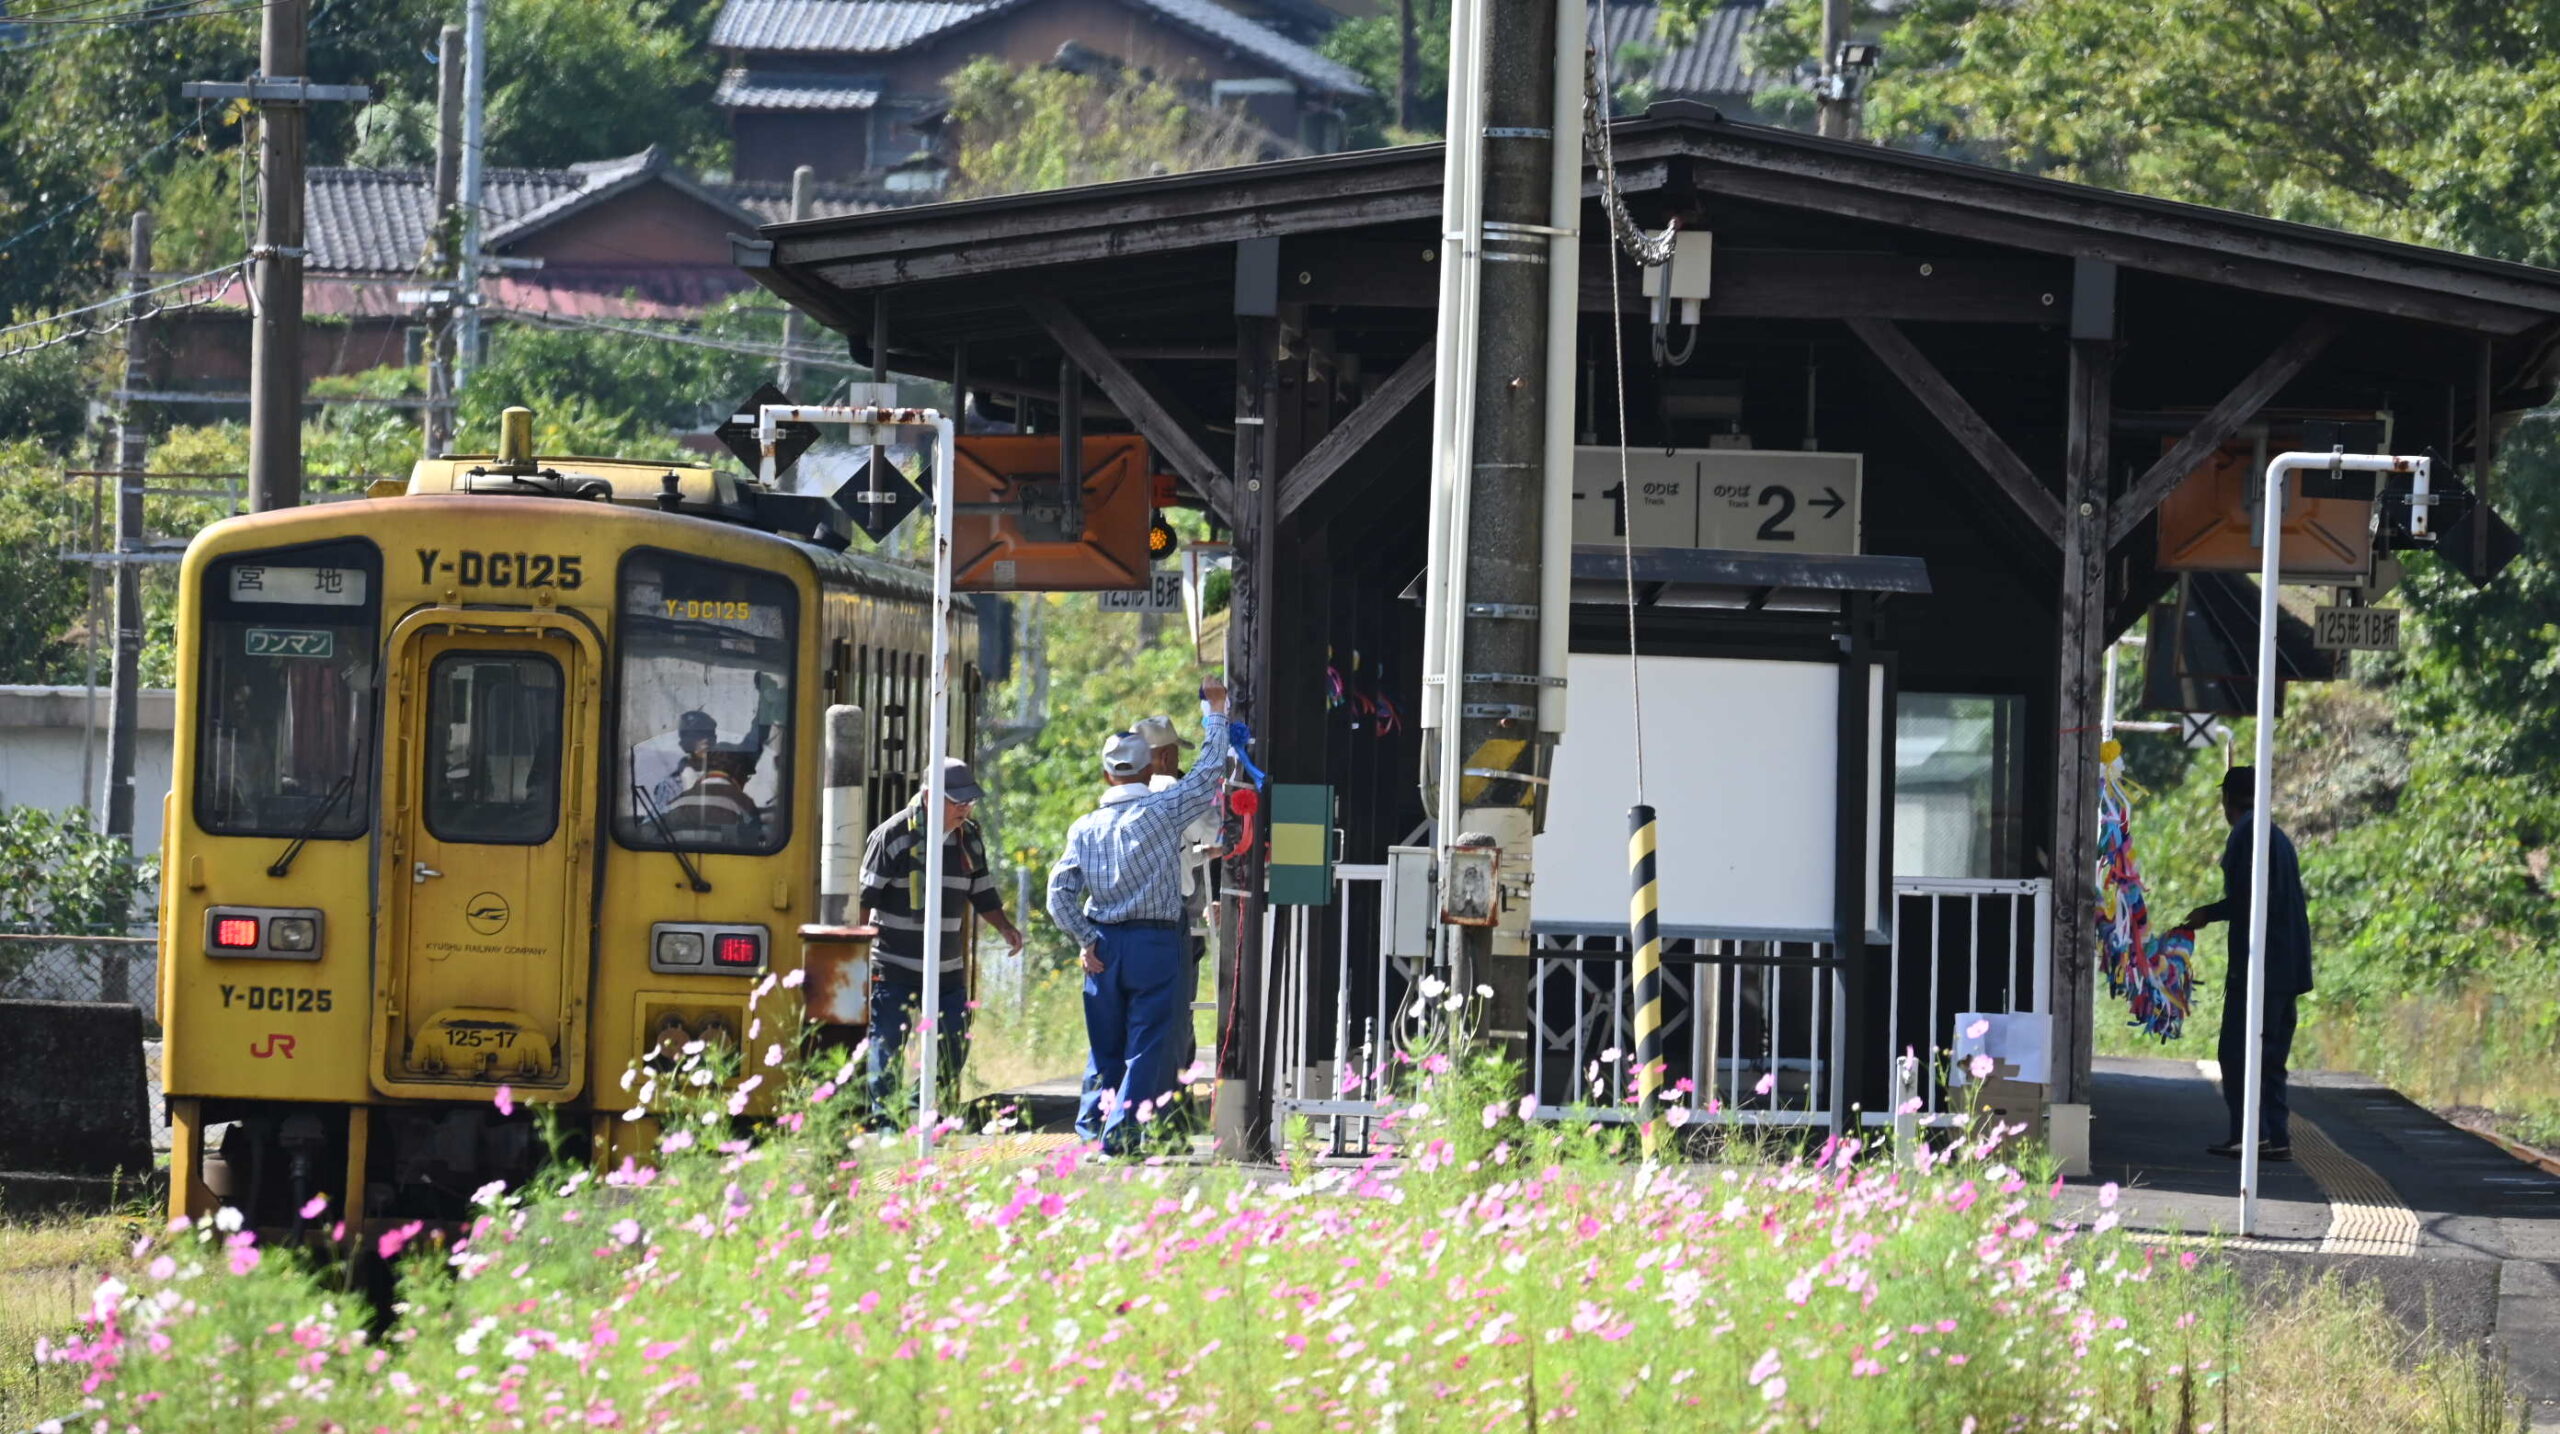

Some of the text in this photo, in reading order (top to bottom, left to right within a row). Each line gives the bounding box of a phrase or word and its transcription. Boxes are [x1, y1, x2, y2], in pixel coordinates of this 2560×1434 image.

[1602, 481, 1680, 537] 1 のりば
[1714, 484, 1796, 541] のりば 2
[417, 549, 582, 590] Y-DC125
[667, 599, 750, 620] Y-DC125
[251, 633, 328, 653] ワンマン
[426, 943, 547, 956] KYUSHU RAILWAY COMPANY
[220, 984, 333, 1013] Y-DC125
[250, 1033, 296, 1060] JR
[445, 1029, 518, 1049] 125-17
